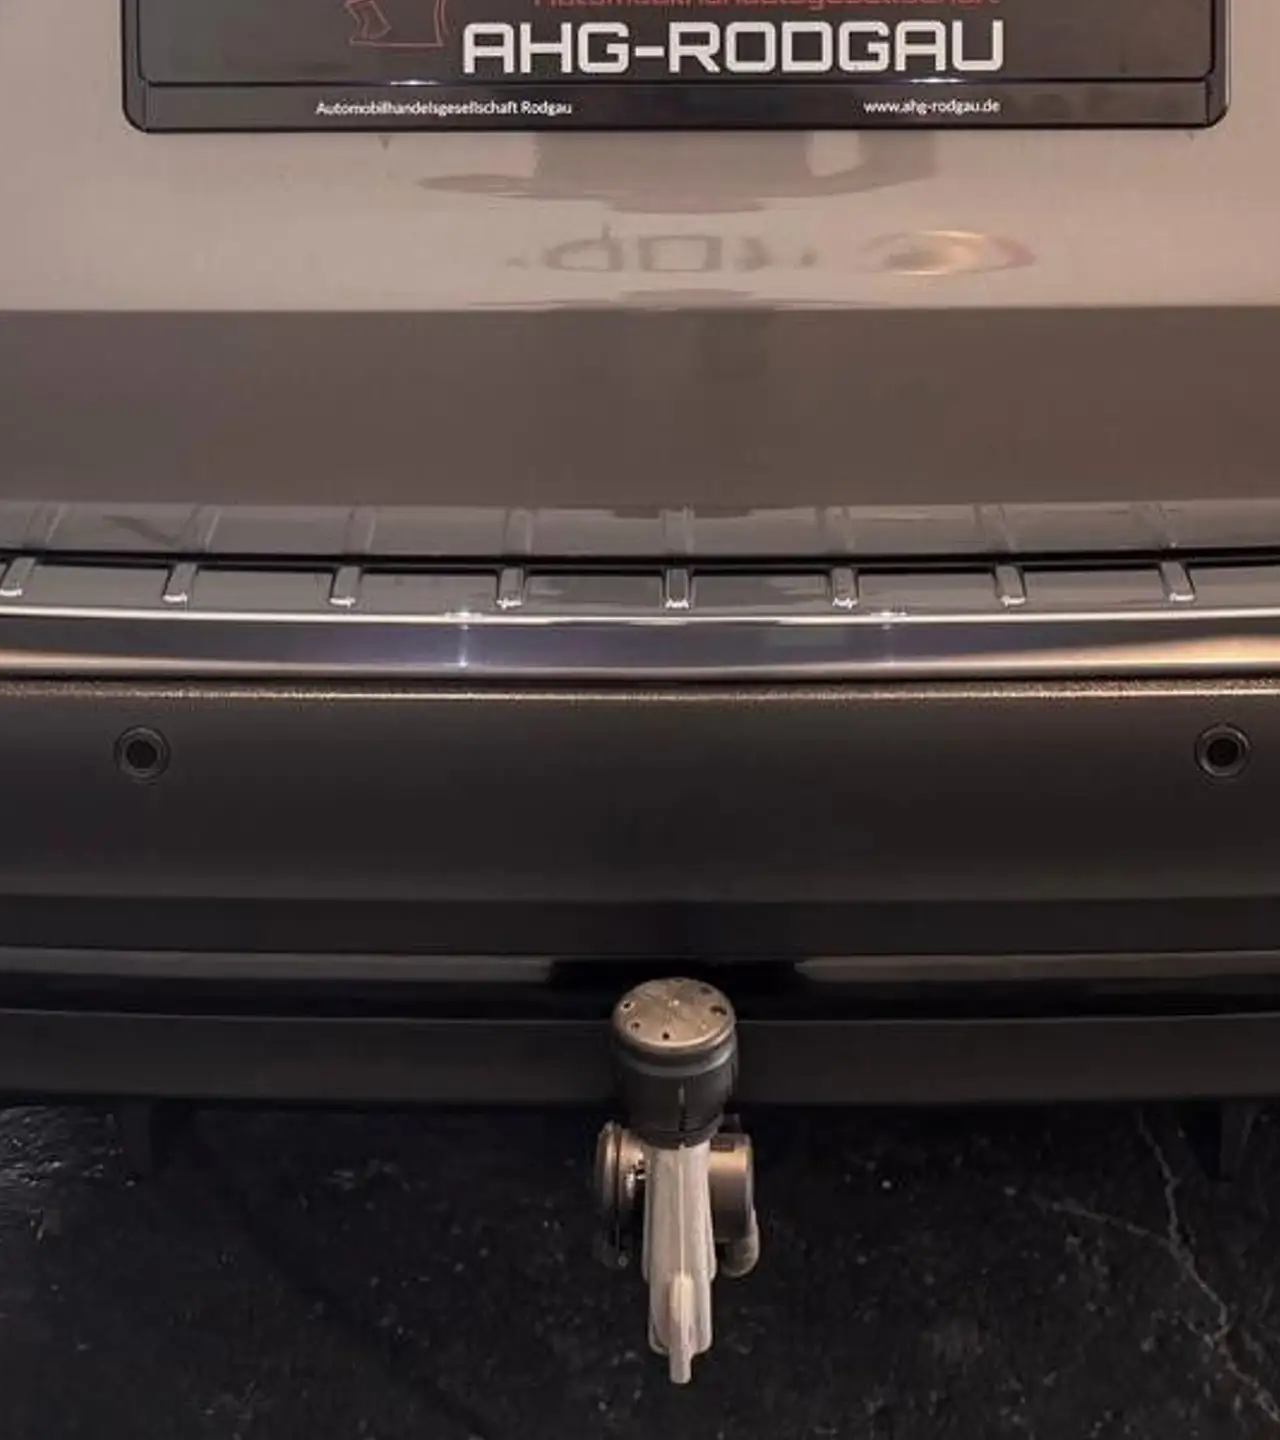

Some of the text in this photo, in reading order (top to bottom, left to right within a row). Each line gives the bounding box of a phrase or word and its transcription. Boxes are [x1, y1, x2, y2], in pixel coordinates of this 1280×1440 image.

[462, 19, 1004, 74] AHG-RODGAU
[314, 100, 573, 117] Automobilhandelsgesellschaft Rodgau
[862, 98, 1002, 117] www.ahg-rodgau.de
